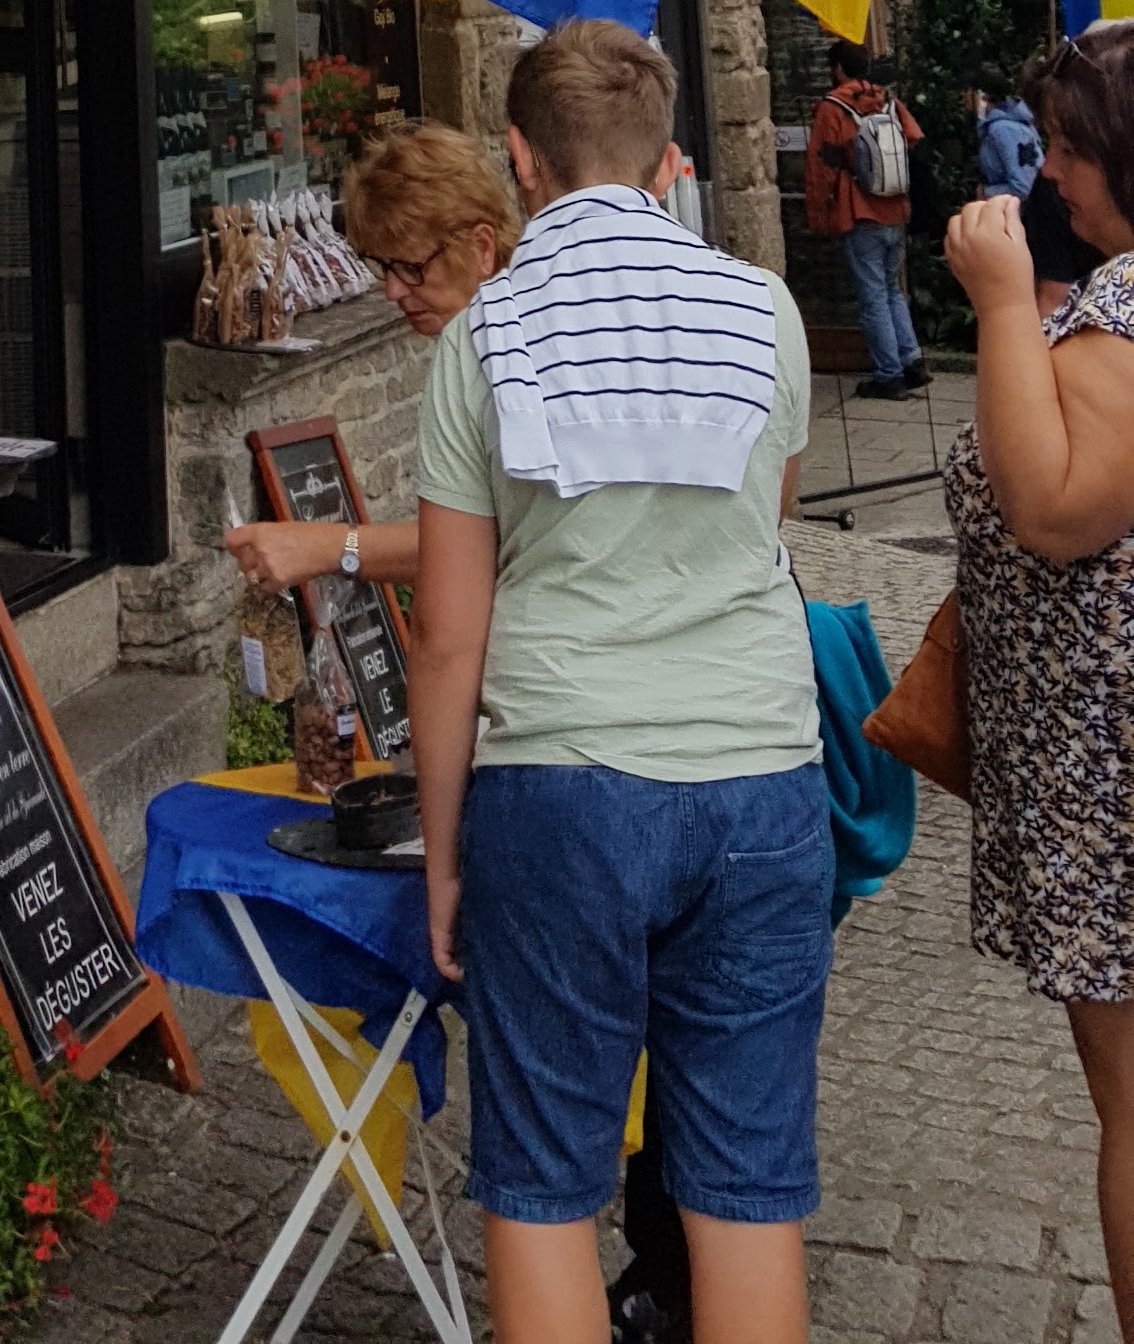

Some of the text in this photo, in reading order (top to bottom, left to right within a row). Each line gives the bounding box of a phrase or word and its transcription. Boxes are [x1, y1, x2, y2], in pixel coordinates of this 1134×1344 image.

[360, 649, 389, 681] VENEZ
[377, 718, 411, 758] DÉGUST
[10, 861, 64, 922] VENEZ
[39, 916, 72, 965] LES
[36, 943, 120, 1031] DÉGUSTER
